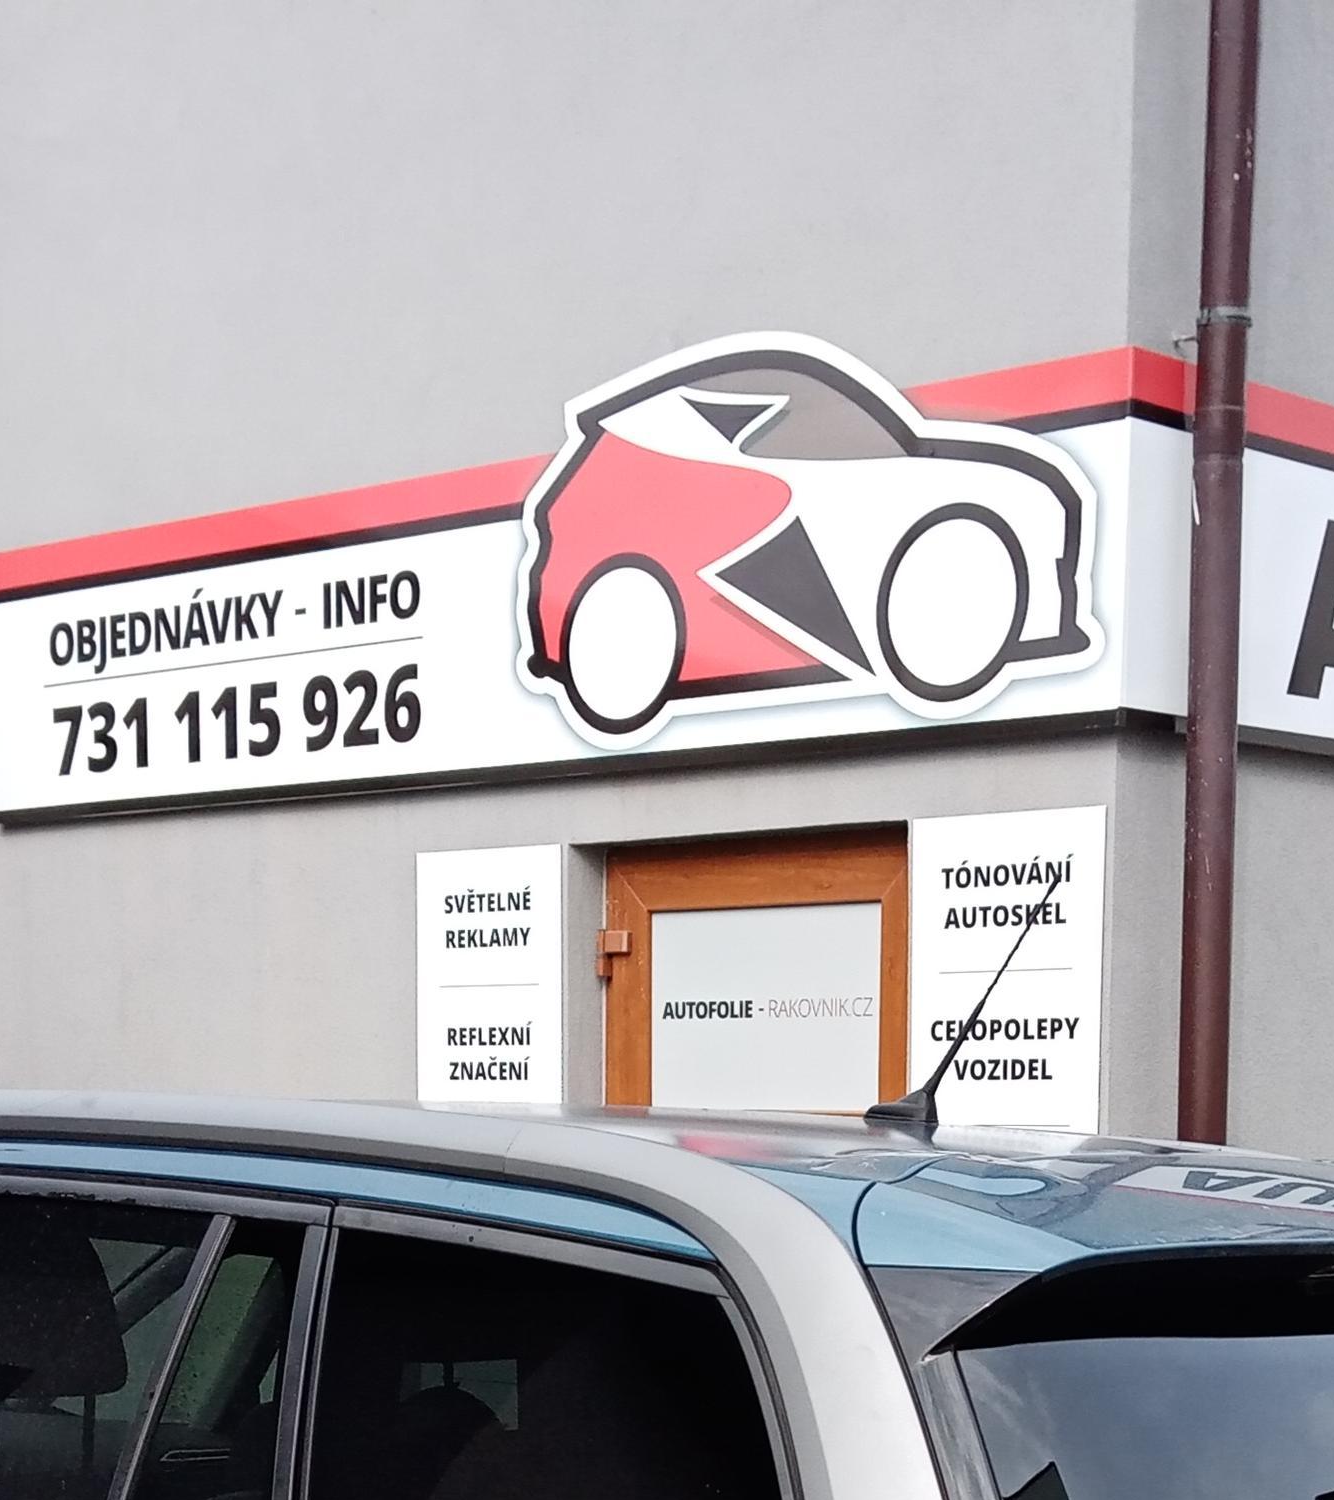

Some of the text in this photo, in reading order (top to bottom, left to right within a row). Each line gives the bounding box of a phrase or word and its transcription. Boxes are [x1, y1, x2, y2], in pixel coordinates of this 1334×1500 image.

[49, 587, 284, 674] OBJEDNÁVKY
[323, 570, 421, 630] INFO
[53, 664, 422, 776] 731 115 926
[941, 852, 1075, 890] TÓNOVÁNÍ
[444, 885, 531, 914] SVĚTELNÉ
[943, 901, 1067, 930] AUTOSKEL
[445, 926, 531, 949] REKLAMY
[662, 1000, 754, 1020] AUTOFOLIE
[768, 996, 874, 1018] RAKOVNIK.CZ
[447, 1020, 533, 1046] REFLEXNÍ
[930, 1016, 1080, 1042] CELOPOLEPY
[449, 1056, 530, 1081] ZNAČENÍ
[953, 1058, 1053, 1081] VOZIDEL
